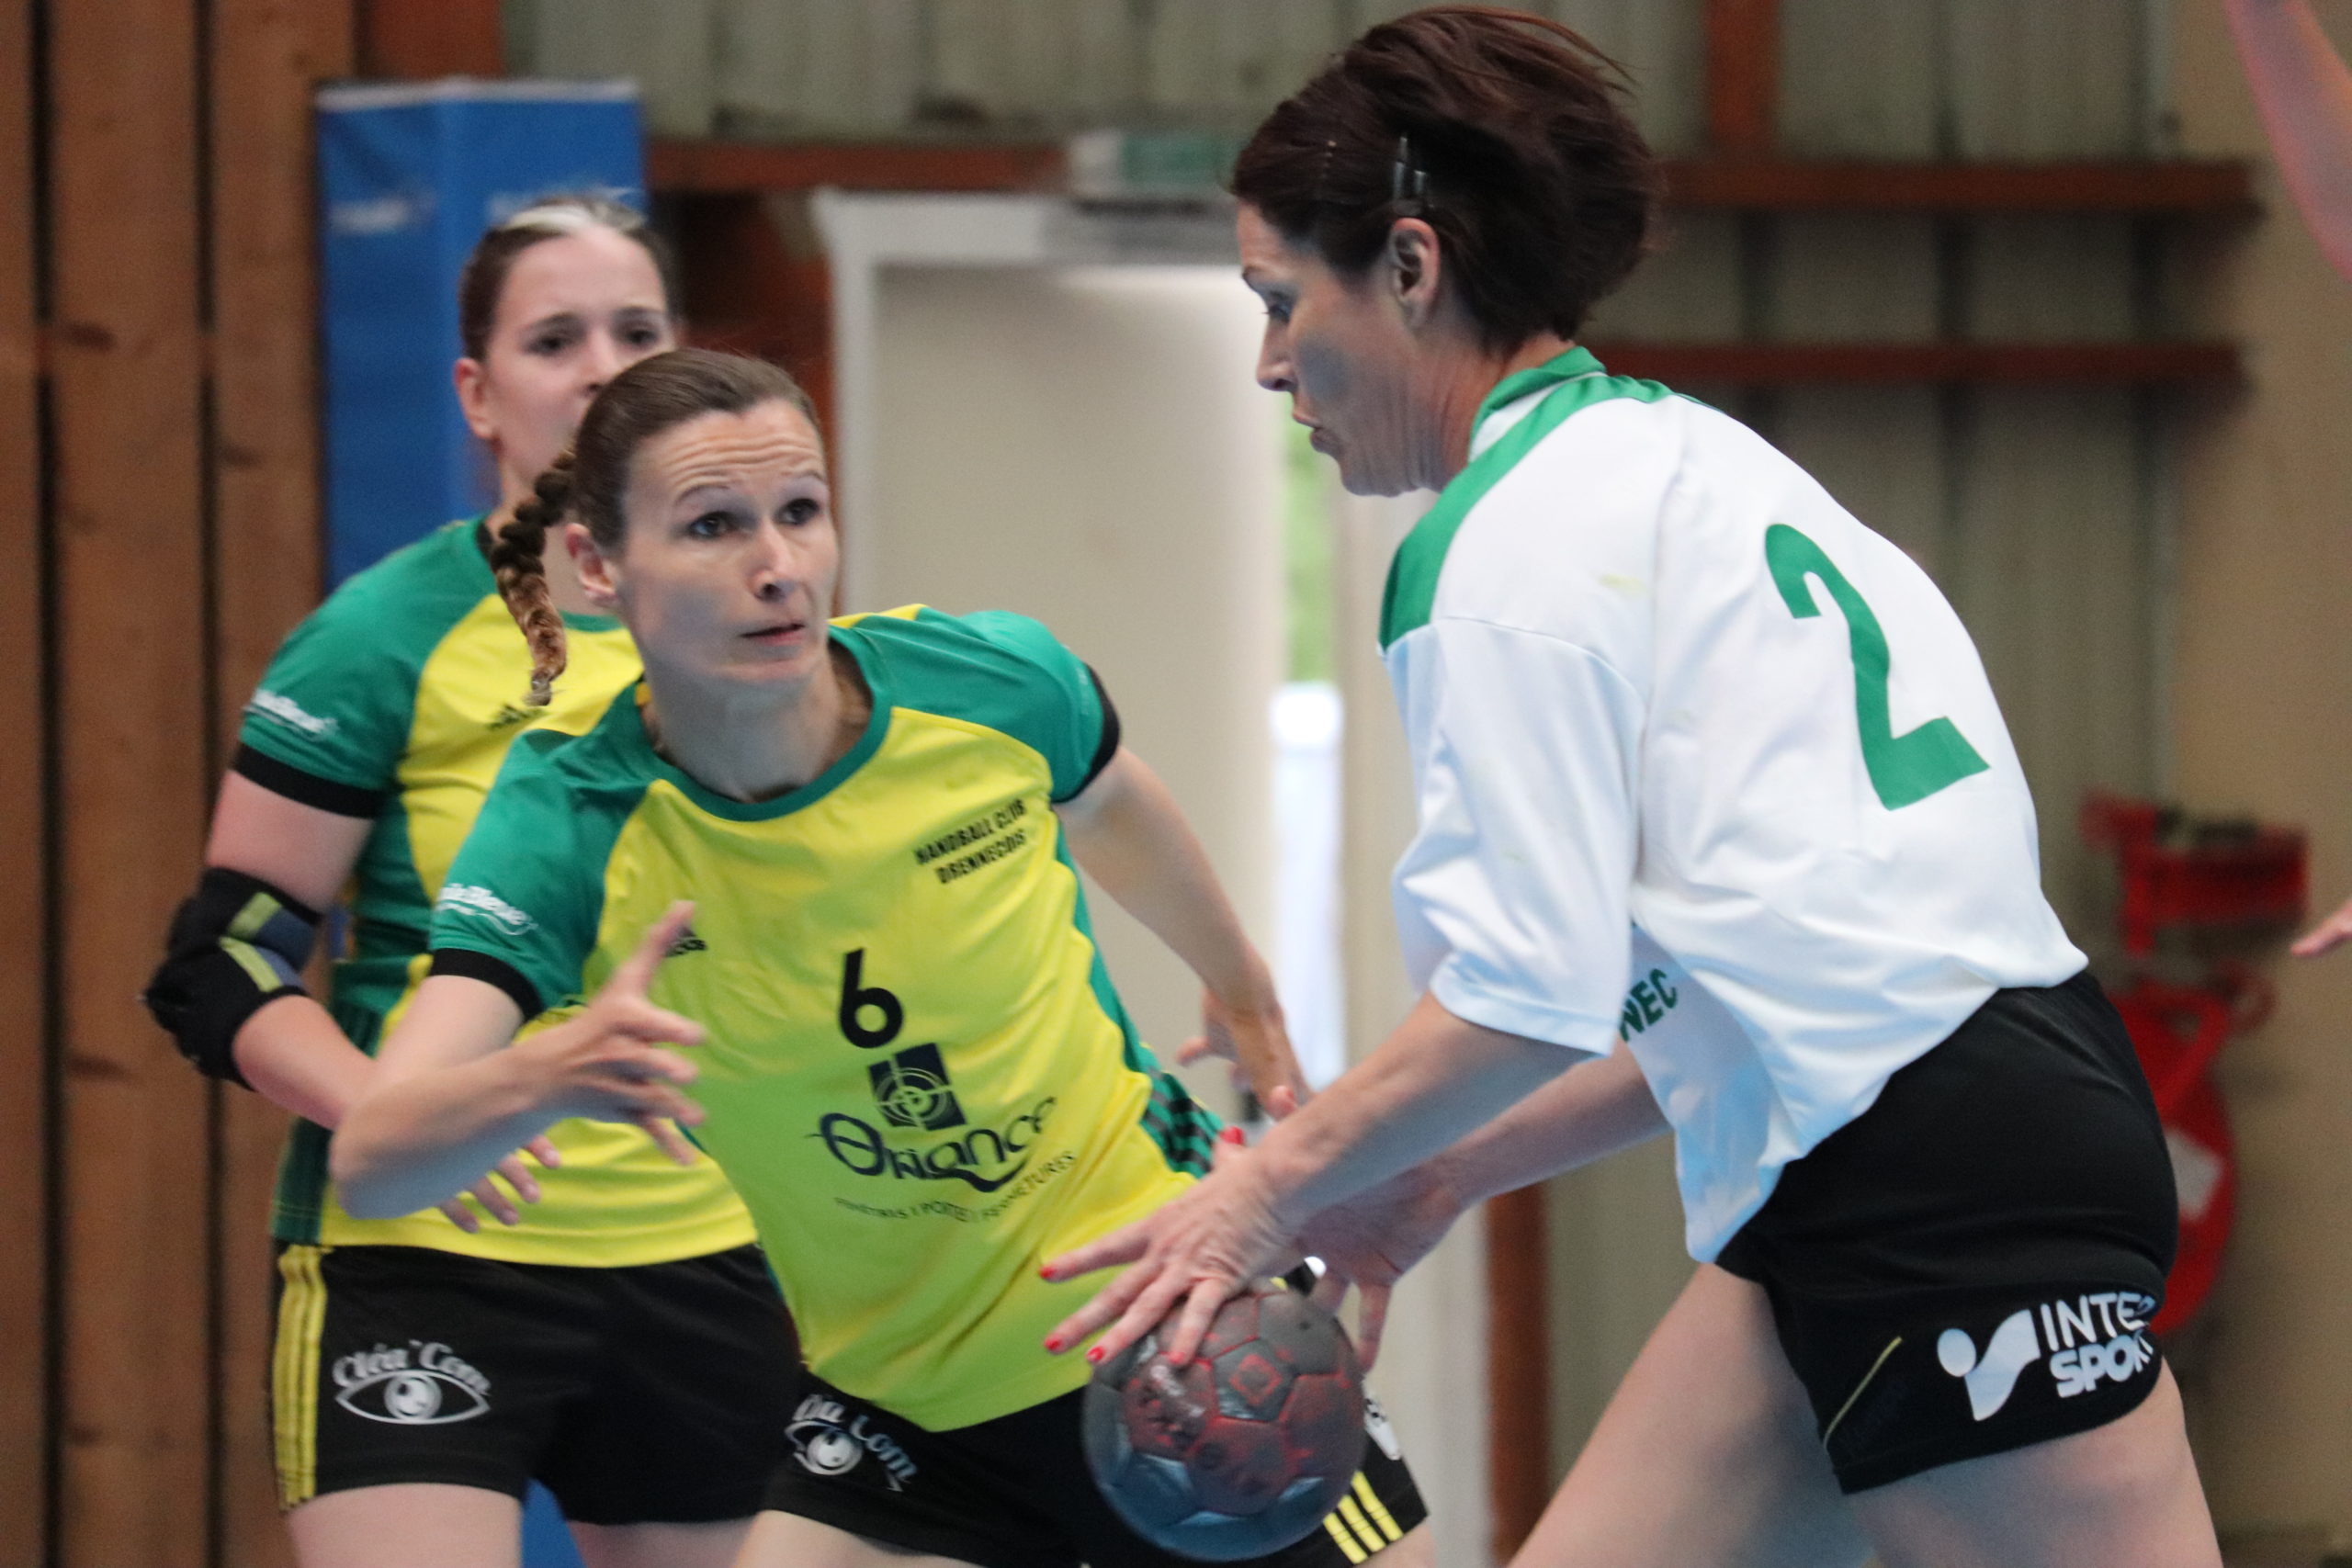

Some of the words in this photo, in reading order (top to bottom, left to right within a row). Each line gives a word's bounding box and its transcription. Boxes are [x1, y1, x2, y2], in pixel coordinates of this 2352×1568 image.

[1765, 523, 1991, 811] 2
[914, 818, 994, 865] HANDBALL
[995, 798, 1026, 829] CLUB
[840, 947, 904, 1049] 6
